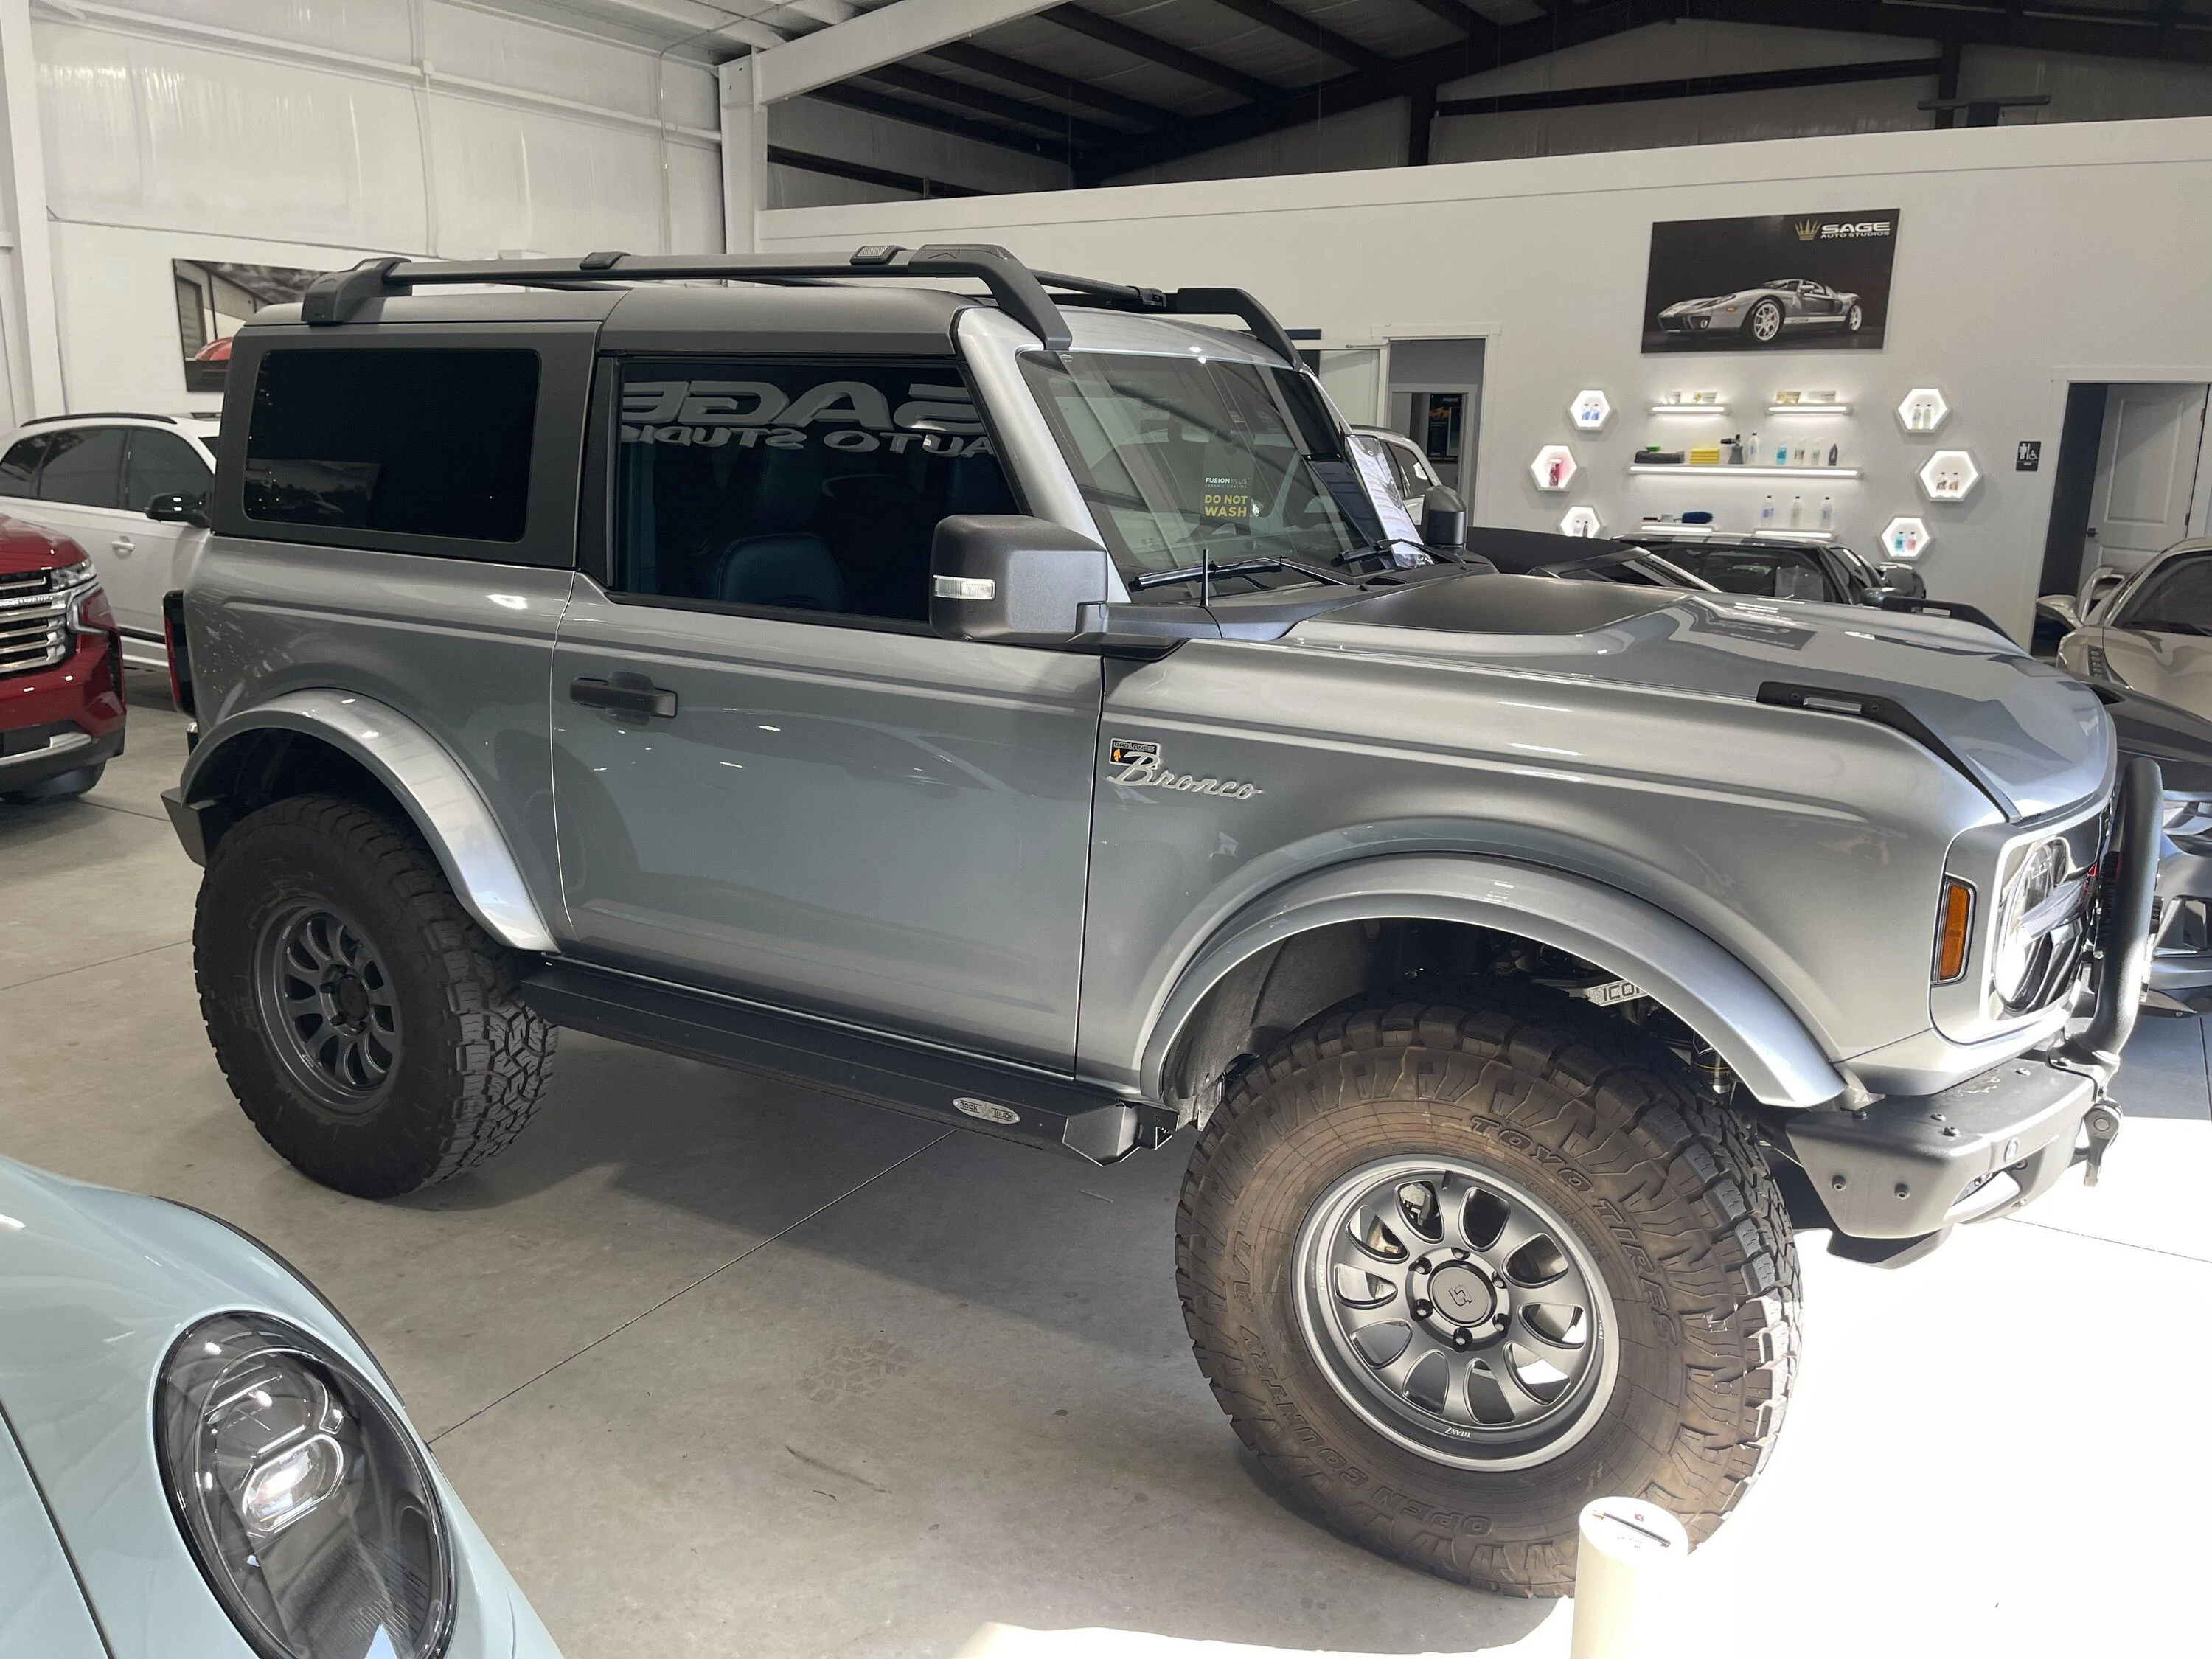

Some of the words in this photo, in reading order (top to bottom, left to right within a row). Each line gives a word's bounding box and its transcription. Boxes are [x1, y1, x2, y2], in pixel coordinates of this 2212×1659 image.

[1821, 222, 1891, 234] SAGE
[1204, 494, 1222, 504] DO
[1224, 495, 1248, 504] NOT
[1204, 506, 1248, 518] WASH
[1113, 741, 1156, 753] BADLANDS
[1107, 751, 1263, 800] Bronco
[959, 1102, 979, 1112] ROCK
[1470, 1115, 1595, 1194] TOYO
[1590, 1197, 1679, 1347] TIRES
[1239, 1325, 1370, 1488] COUNTRY
[1445, 1427, 1471, 1438] TITAN7
[1371, 1485, 1493, 1537] OPEN
